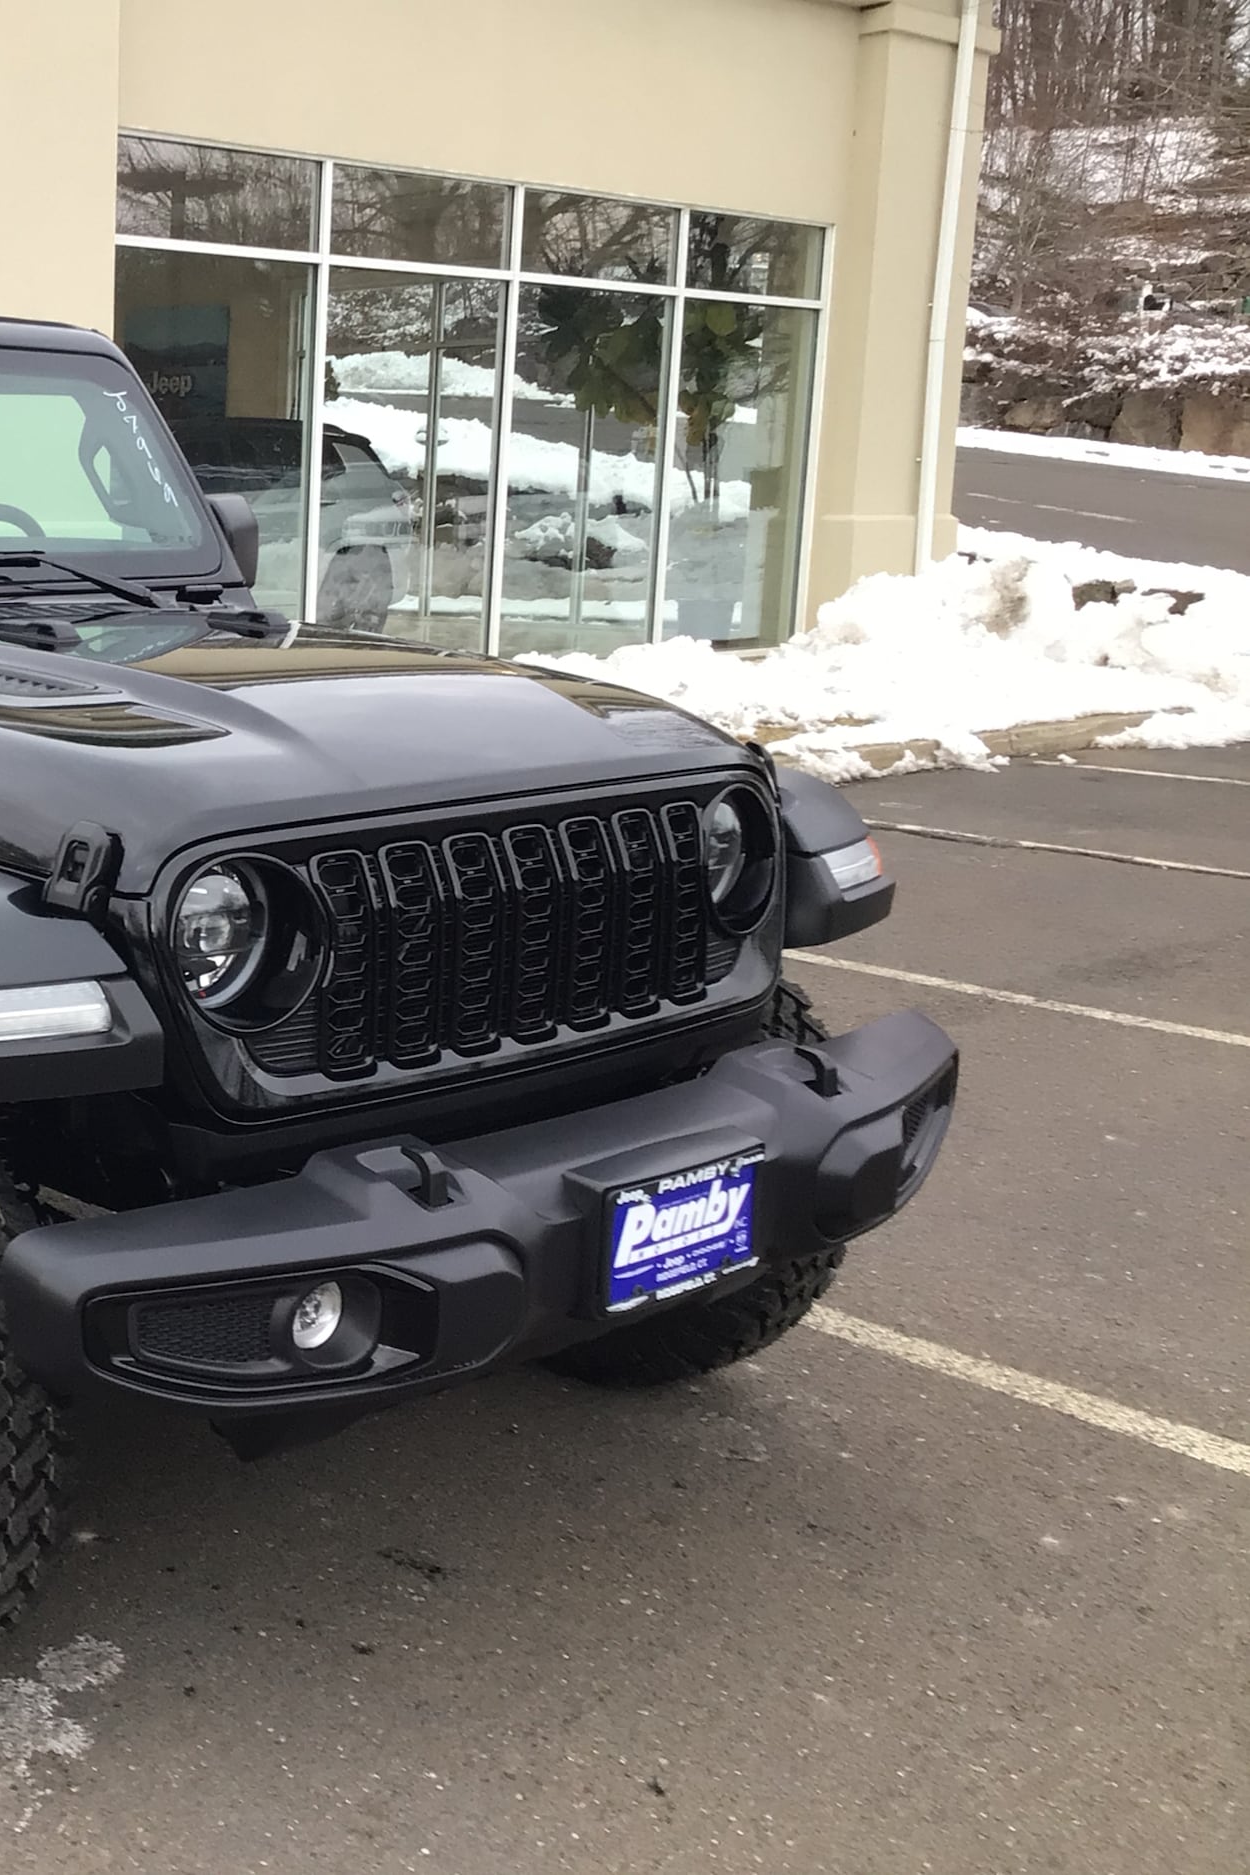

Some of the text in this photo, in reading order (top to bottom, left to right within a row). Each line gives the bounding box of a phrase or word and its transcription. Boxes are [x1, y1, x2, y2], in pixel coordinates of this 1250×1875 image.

[147, 370, 192, 397] Jeep
[657, 1161, 730, 1194] PAMBY
[613, 1179, 751, 1269] Pamby
